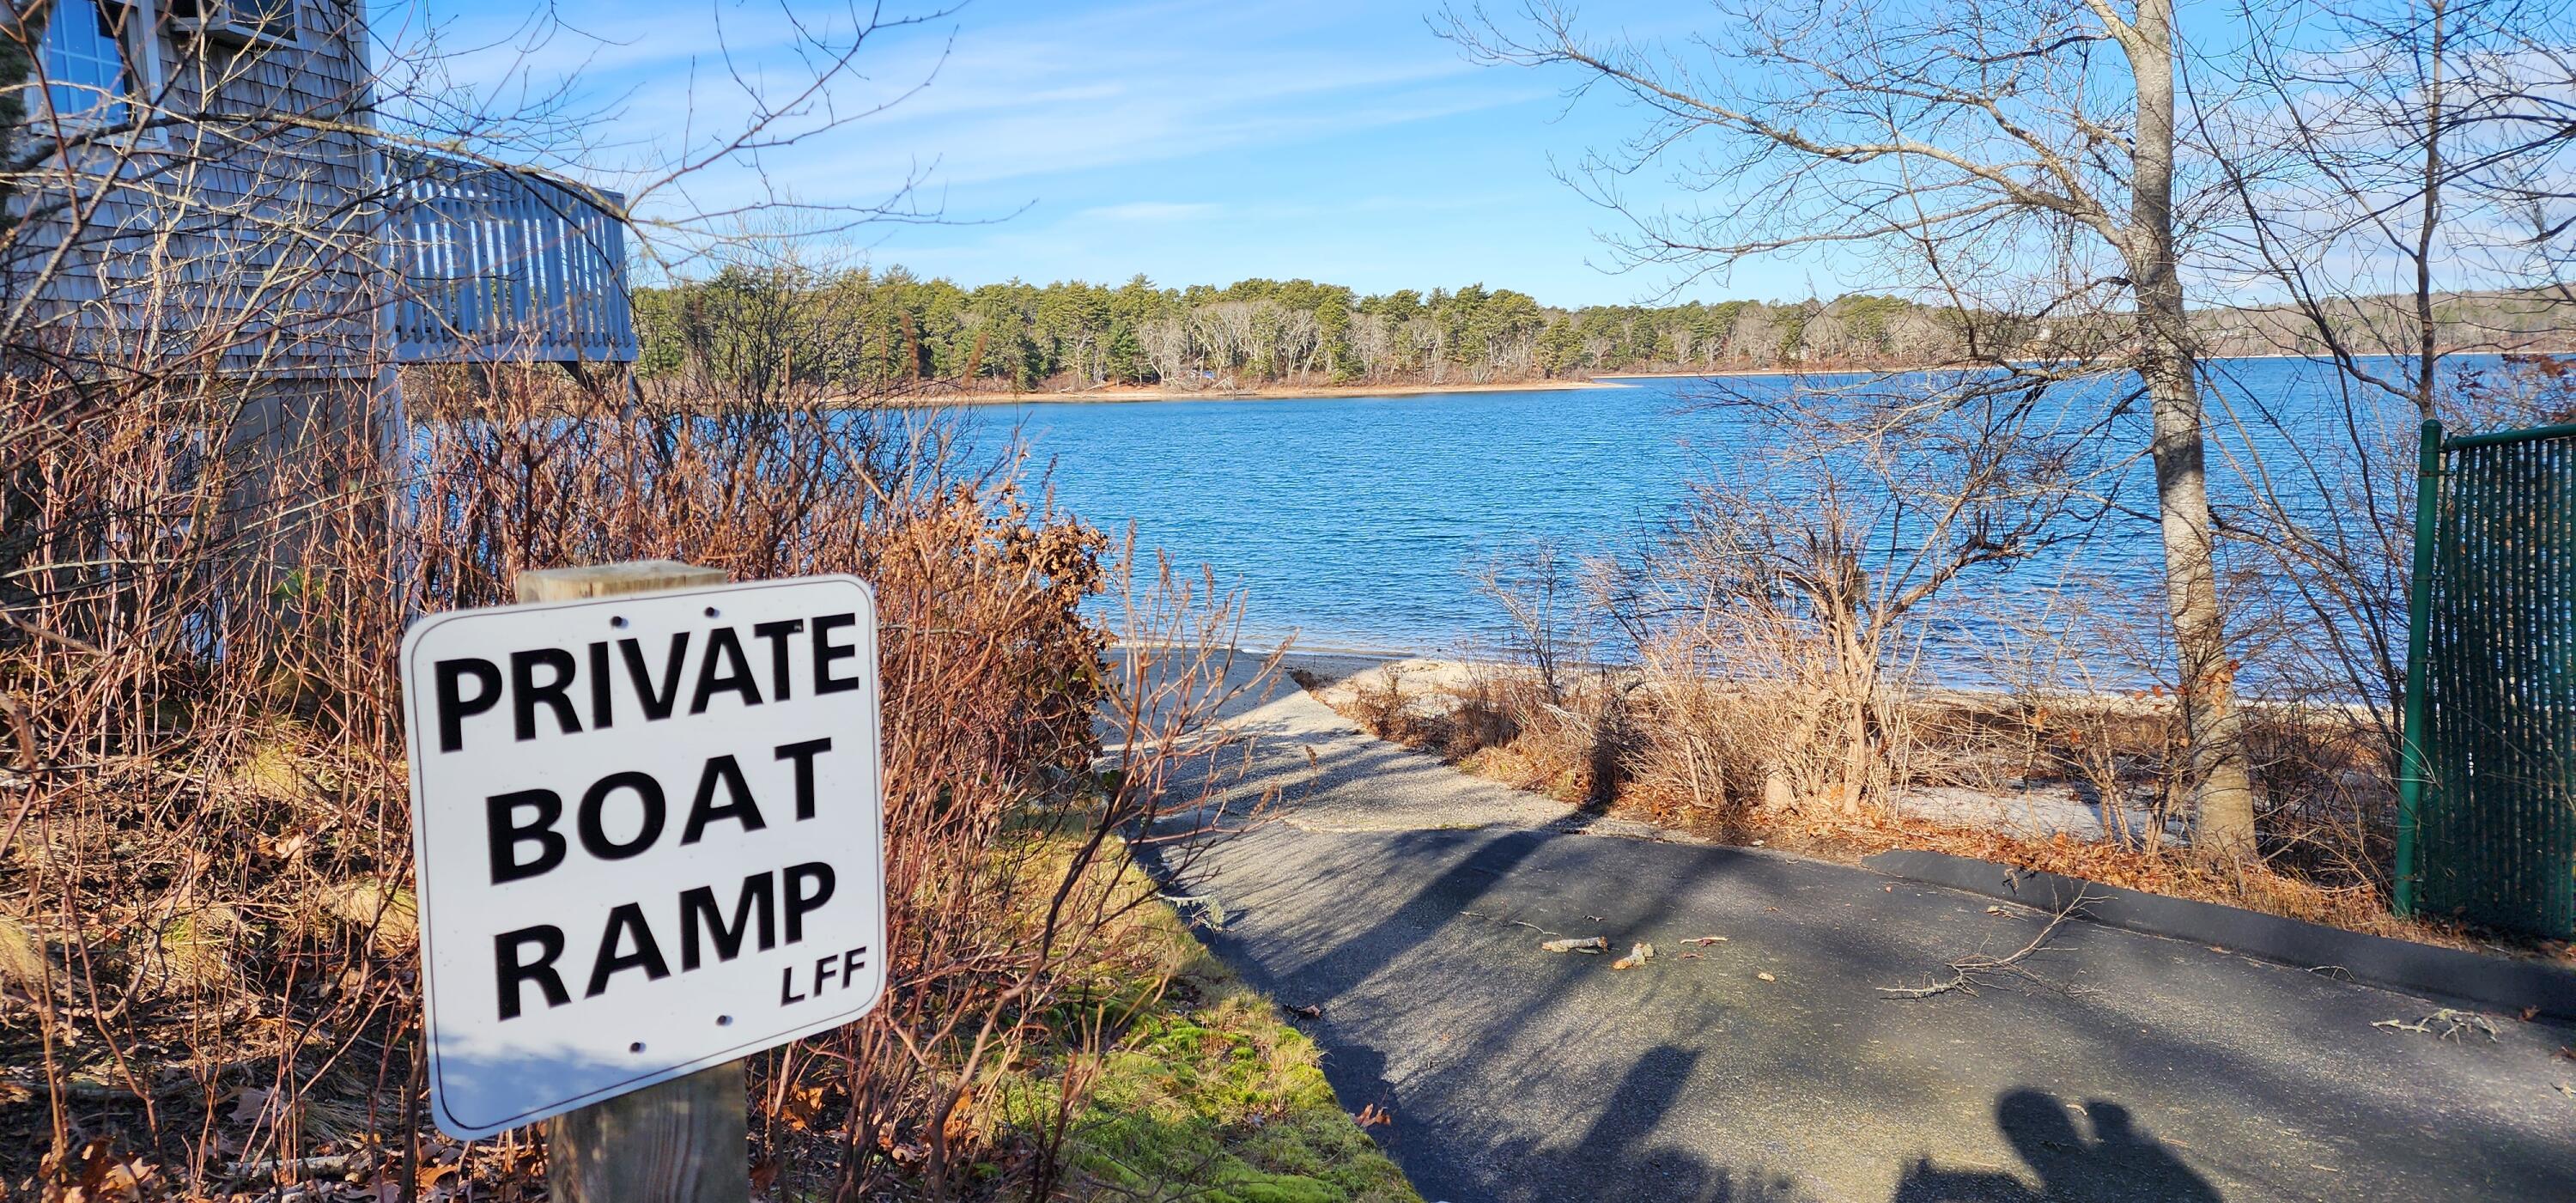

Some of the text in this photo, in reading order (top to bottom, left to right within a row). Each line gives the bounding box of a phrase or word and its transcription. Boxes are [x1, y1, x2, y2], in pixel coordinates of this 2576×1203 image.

[434, 612, 860, 753] PRIVATE
[486, 737, 832, 885] BOAT
[494, 861, 836, 1022] RAMP
[781, 946, 867, 1006] LFF
